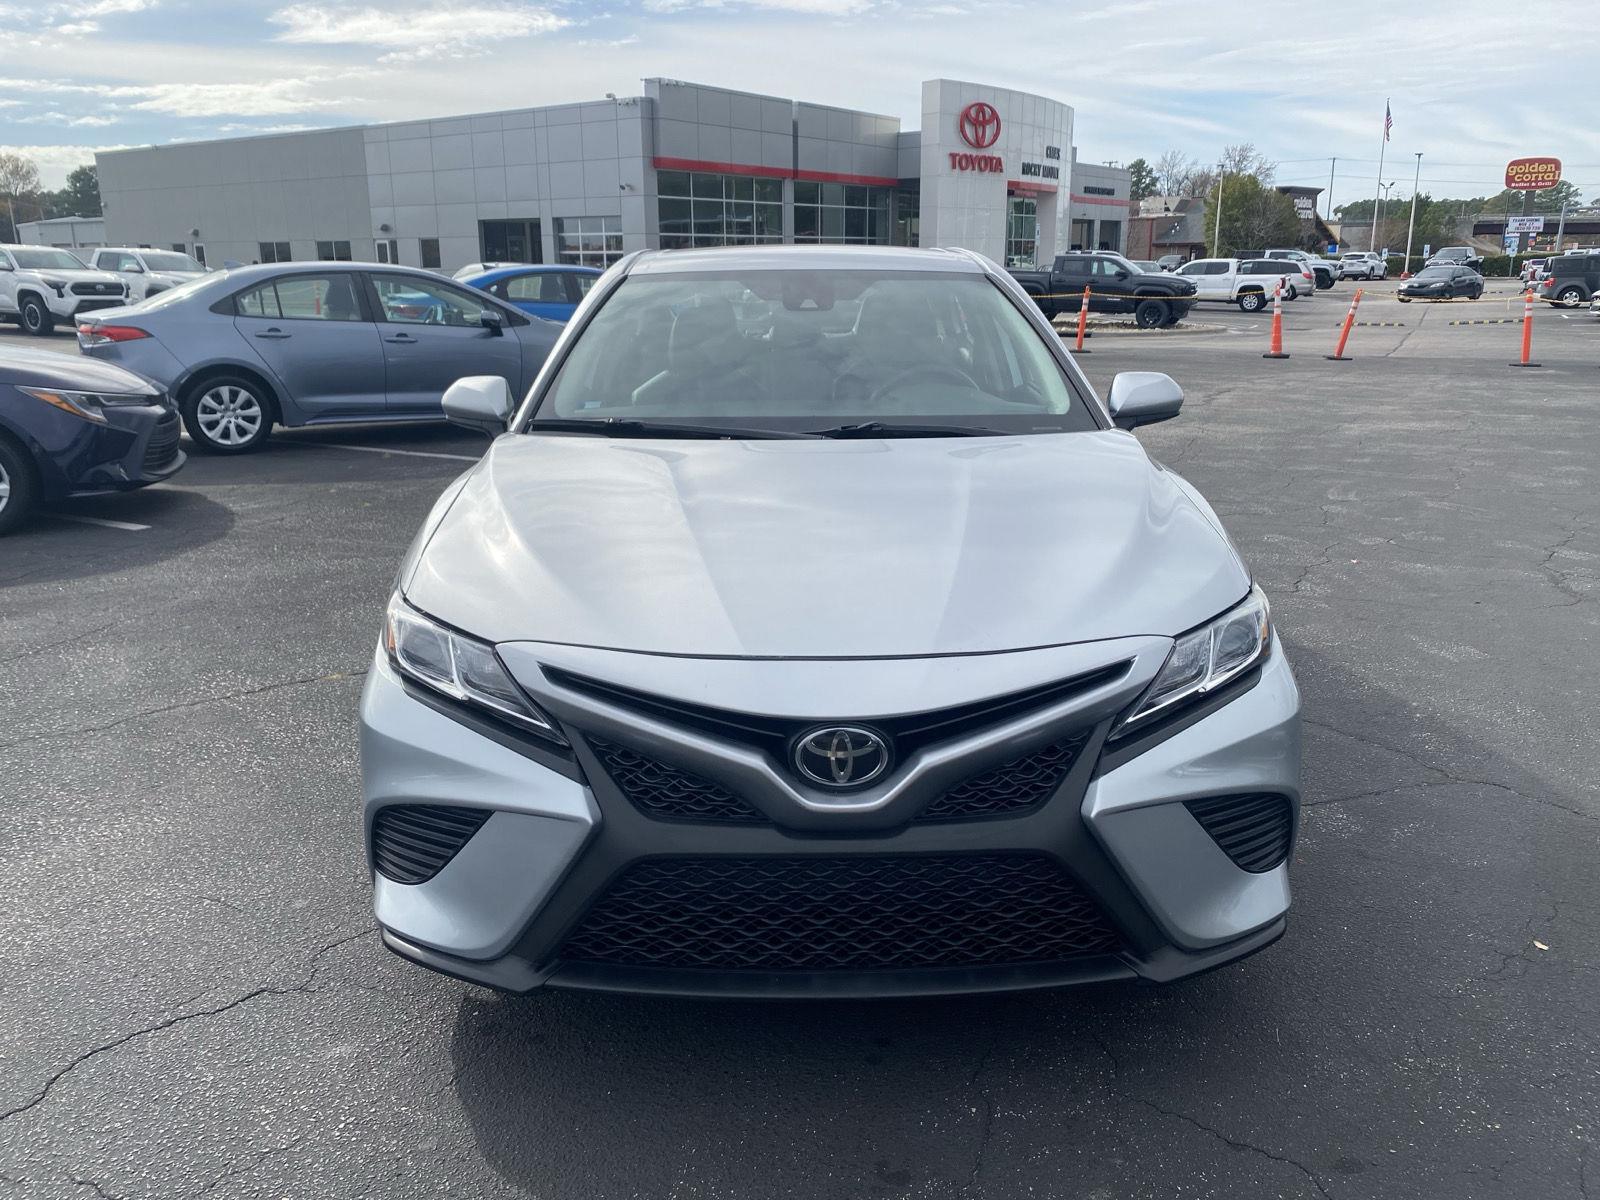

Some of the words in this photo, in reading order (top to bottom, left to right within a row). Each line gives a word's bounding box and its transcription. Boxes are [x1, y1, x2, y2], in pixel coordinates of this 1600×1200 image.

[949, 152, 1004, 173] TOYOTA
[1022, 162, 1041, 176] ROCKY
[1508, 163, 1555, 176] golden
[1514, 170, 1560, 181] corral
